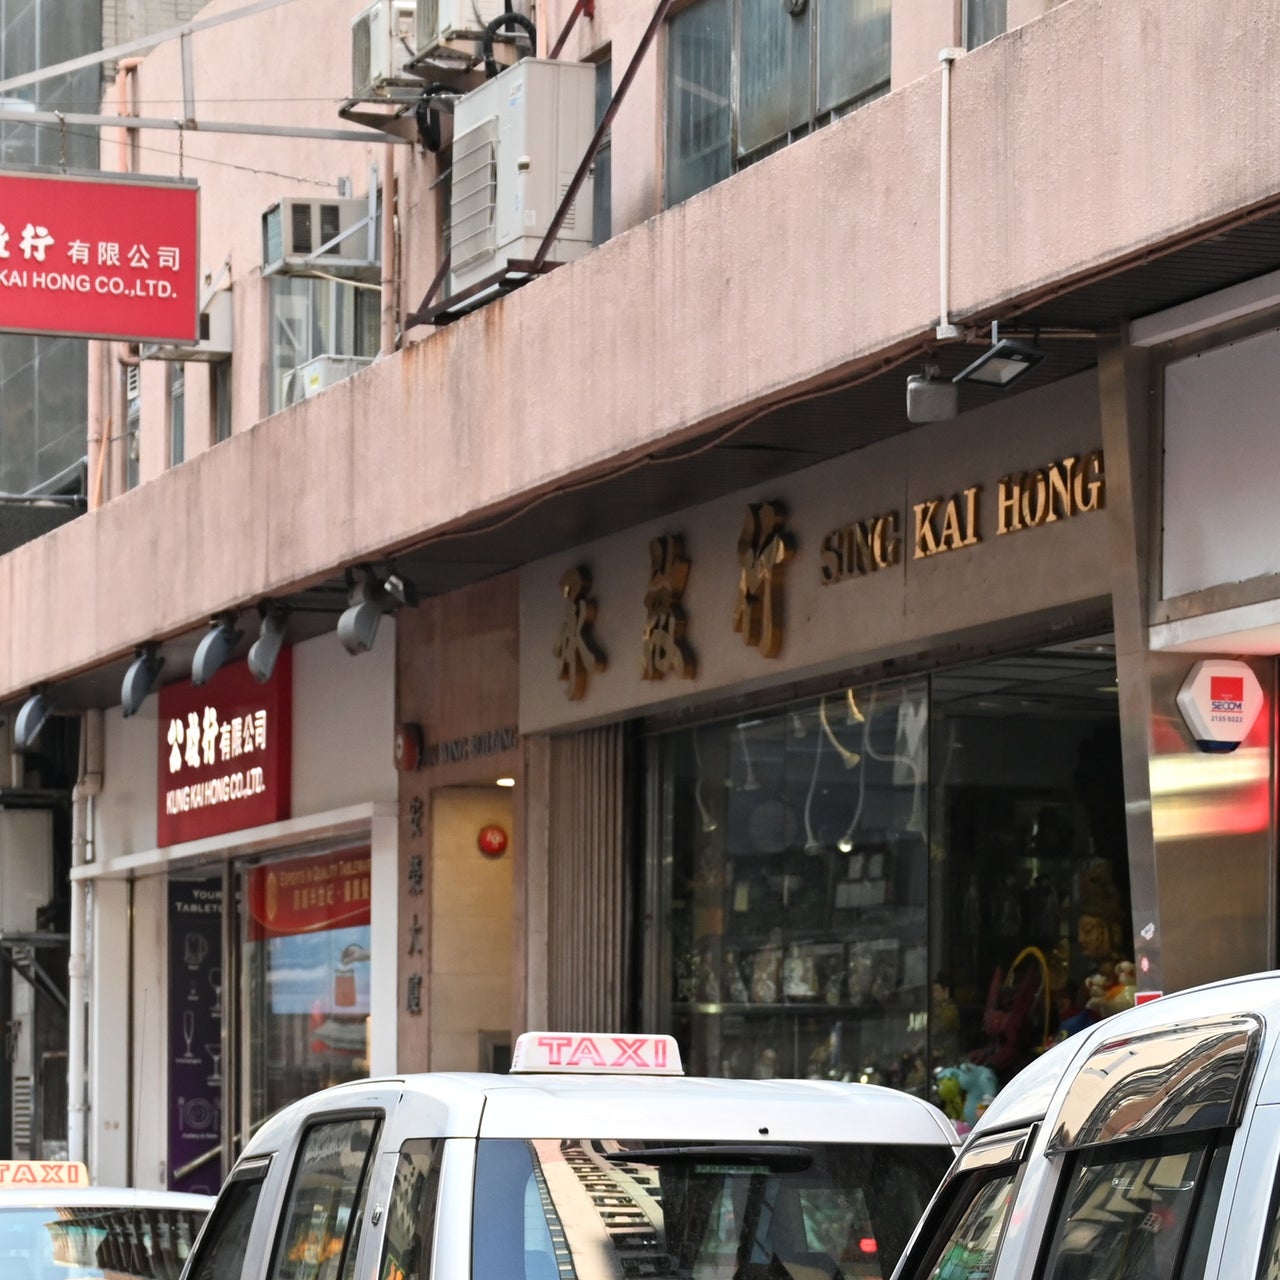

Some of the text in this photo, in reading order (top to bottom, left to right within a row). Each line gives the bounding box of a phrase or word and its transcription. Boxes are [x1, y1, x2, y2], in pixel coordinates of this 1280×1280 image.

[32, 272, 91, 293] HONG
[95, 276, 178, 299] CO.,LTD.
[820, 449, 1105, 585] SING KAI HONG
[1210, 700, 1242, 711] SECOM
[166, 786, 190, 815] KUNG
[190, 782, 205, 809] KAI
[205, 775, 230, 806] HONG
[537, 1036, 667, 1068] TAXI
